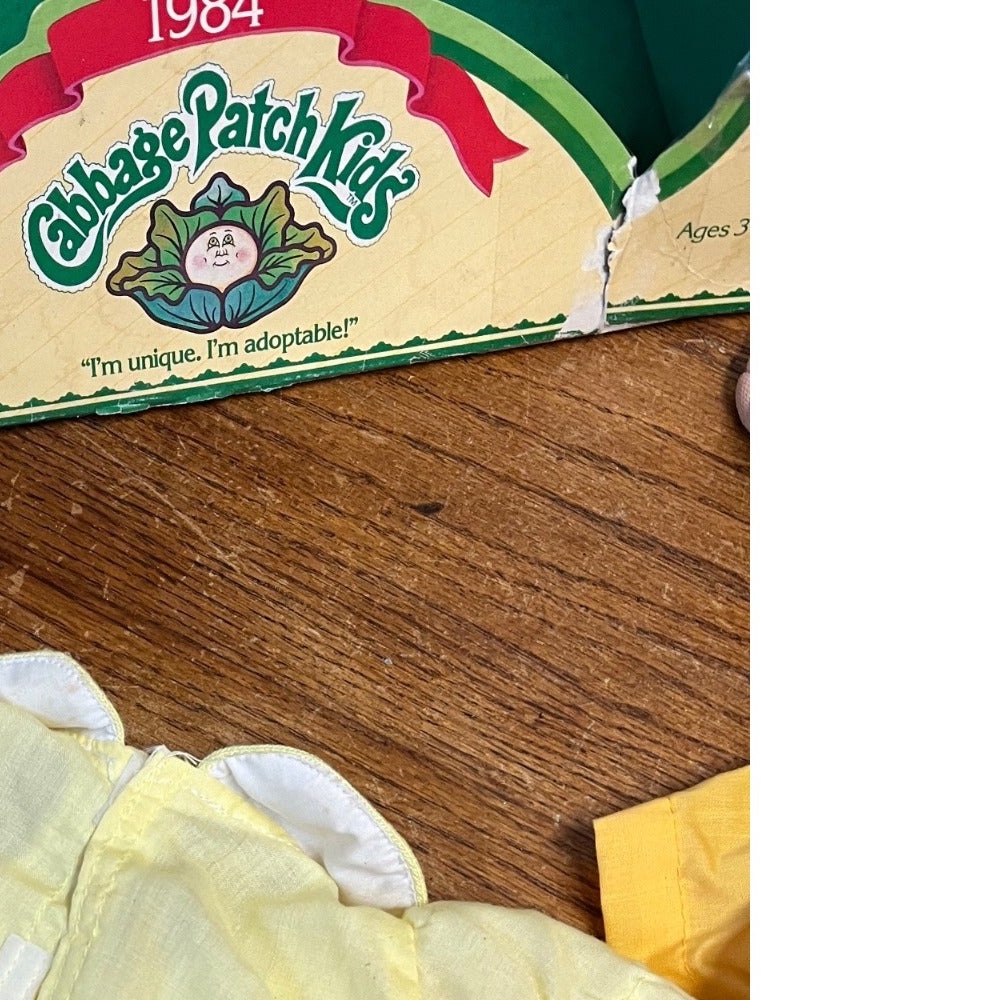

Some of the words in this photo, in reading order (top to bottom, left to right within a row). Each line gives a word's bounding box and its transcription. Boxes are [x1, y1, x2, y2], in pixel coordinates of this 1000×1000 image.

[147, 0, 264, 42] 1984
[27, 117, 191, 287] Cabbage
[183, 70, 318, 176] Patch
[295, 97, 416, 240] Kids
[676, 222, 730, 243] Ages
[128, 348, 202, 372] unique.
[207, 338, 238, 360] I’m
[244, 317, 358, 353] adoptable!”
